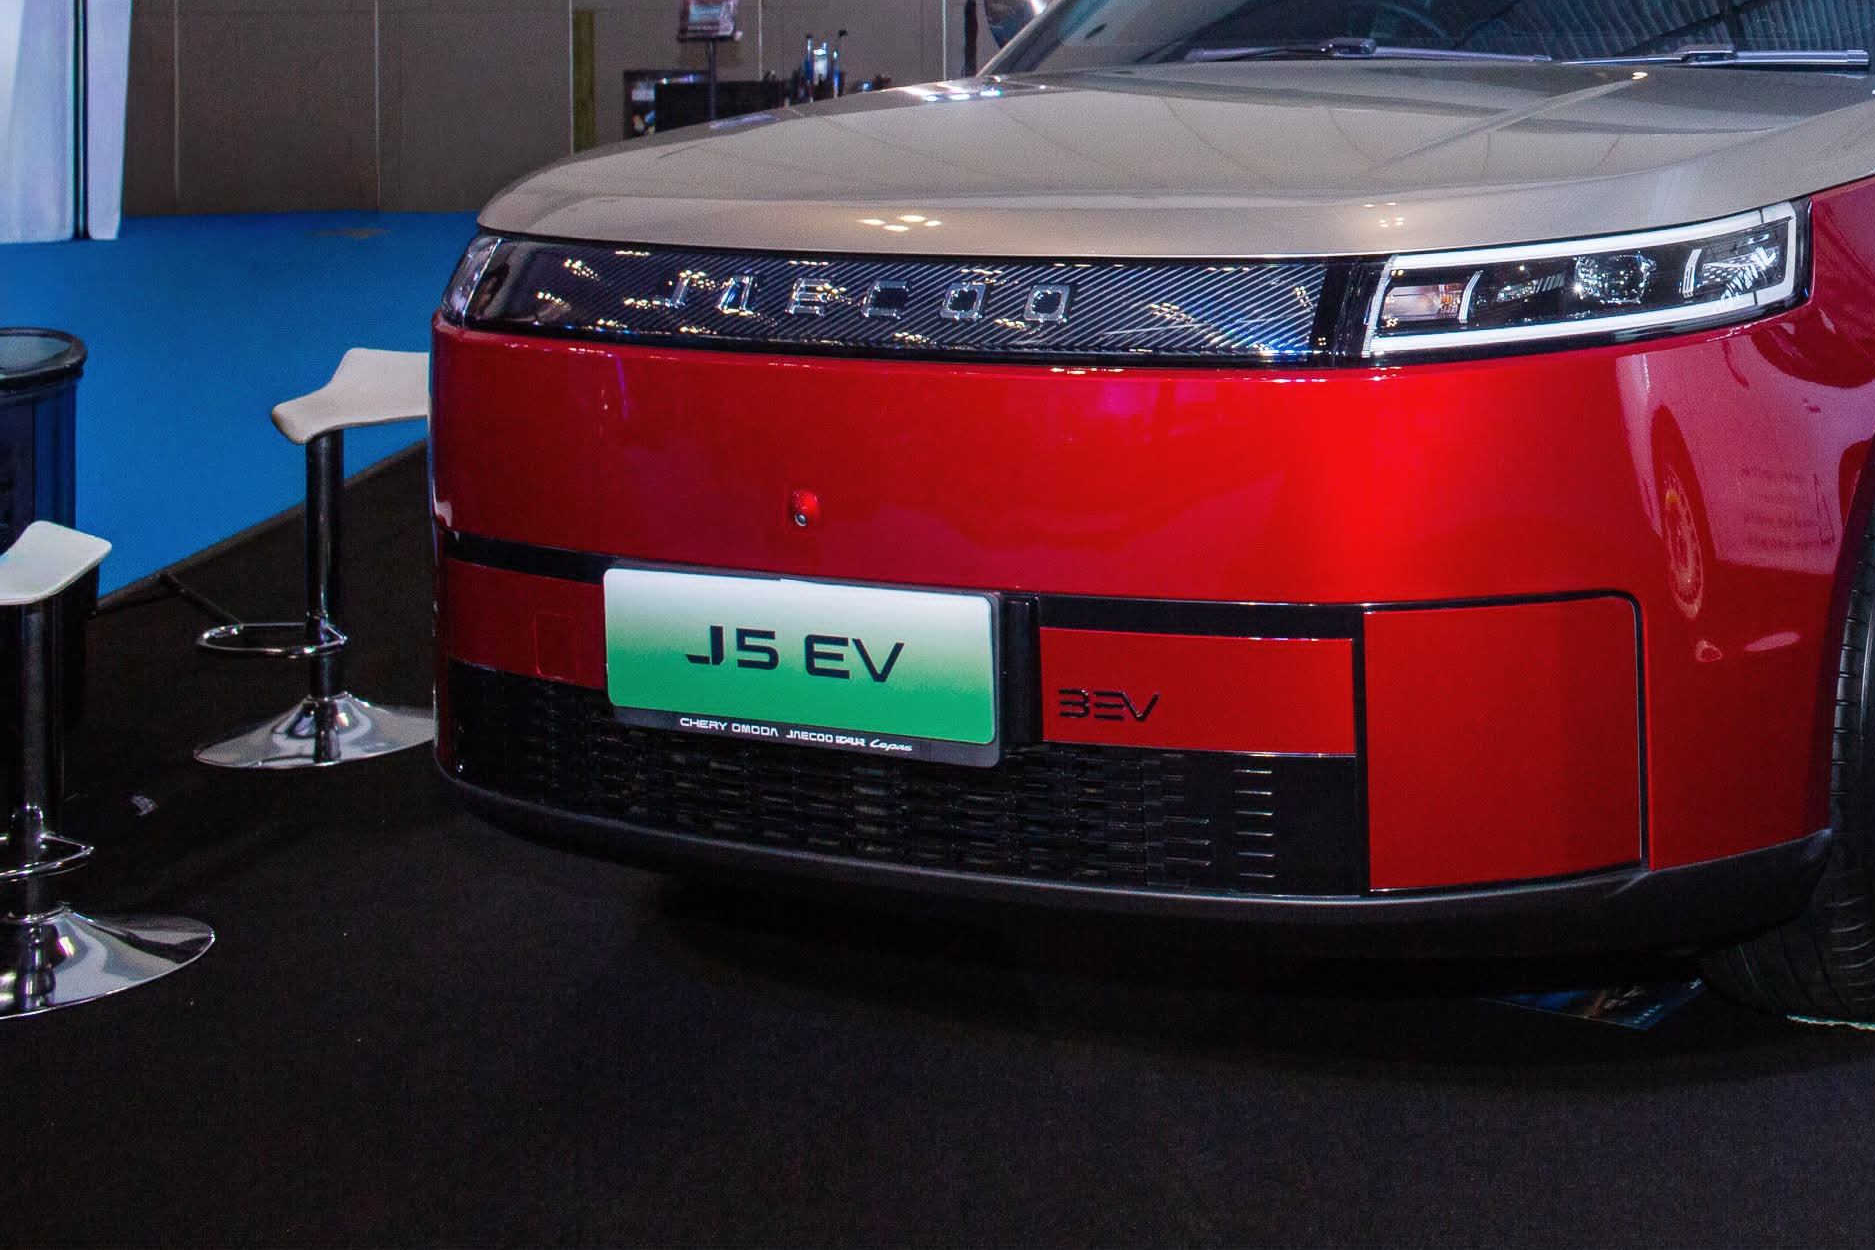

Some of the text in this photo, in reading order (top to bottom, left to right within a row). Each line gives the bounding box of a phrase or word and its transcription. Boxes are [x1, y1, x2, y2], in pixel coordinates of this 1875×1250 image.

[662, 268, 1072, 323] JAECOO
[685, 624, 905, 683] J5 EV
[1058, 687, 1161, 722] BEV
[679, 716, 728, 731] CHERY
[731, 723, 779, 738] OMODA
[786, 729, 834, 744] JAECOO
